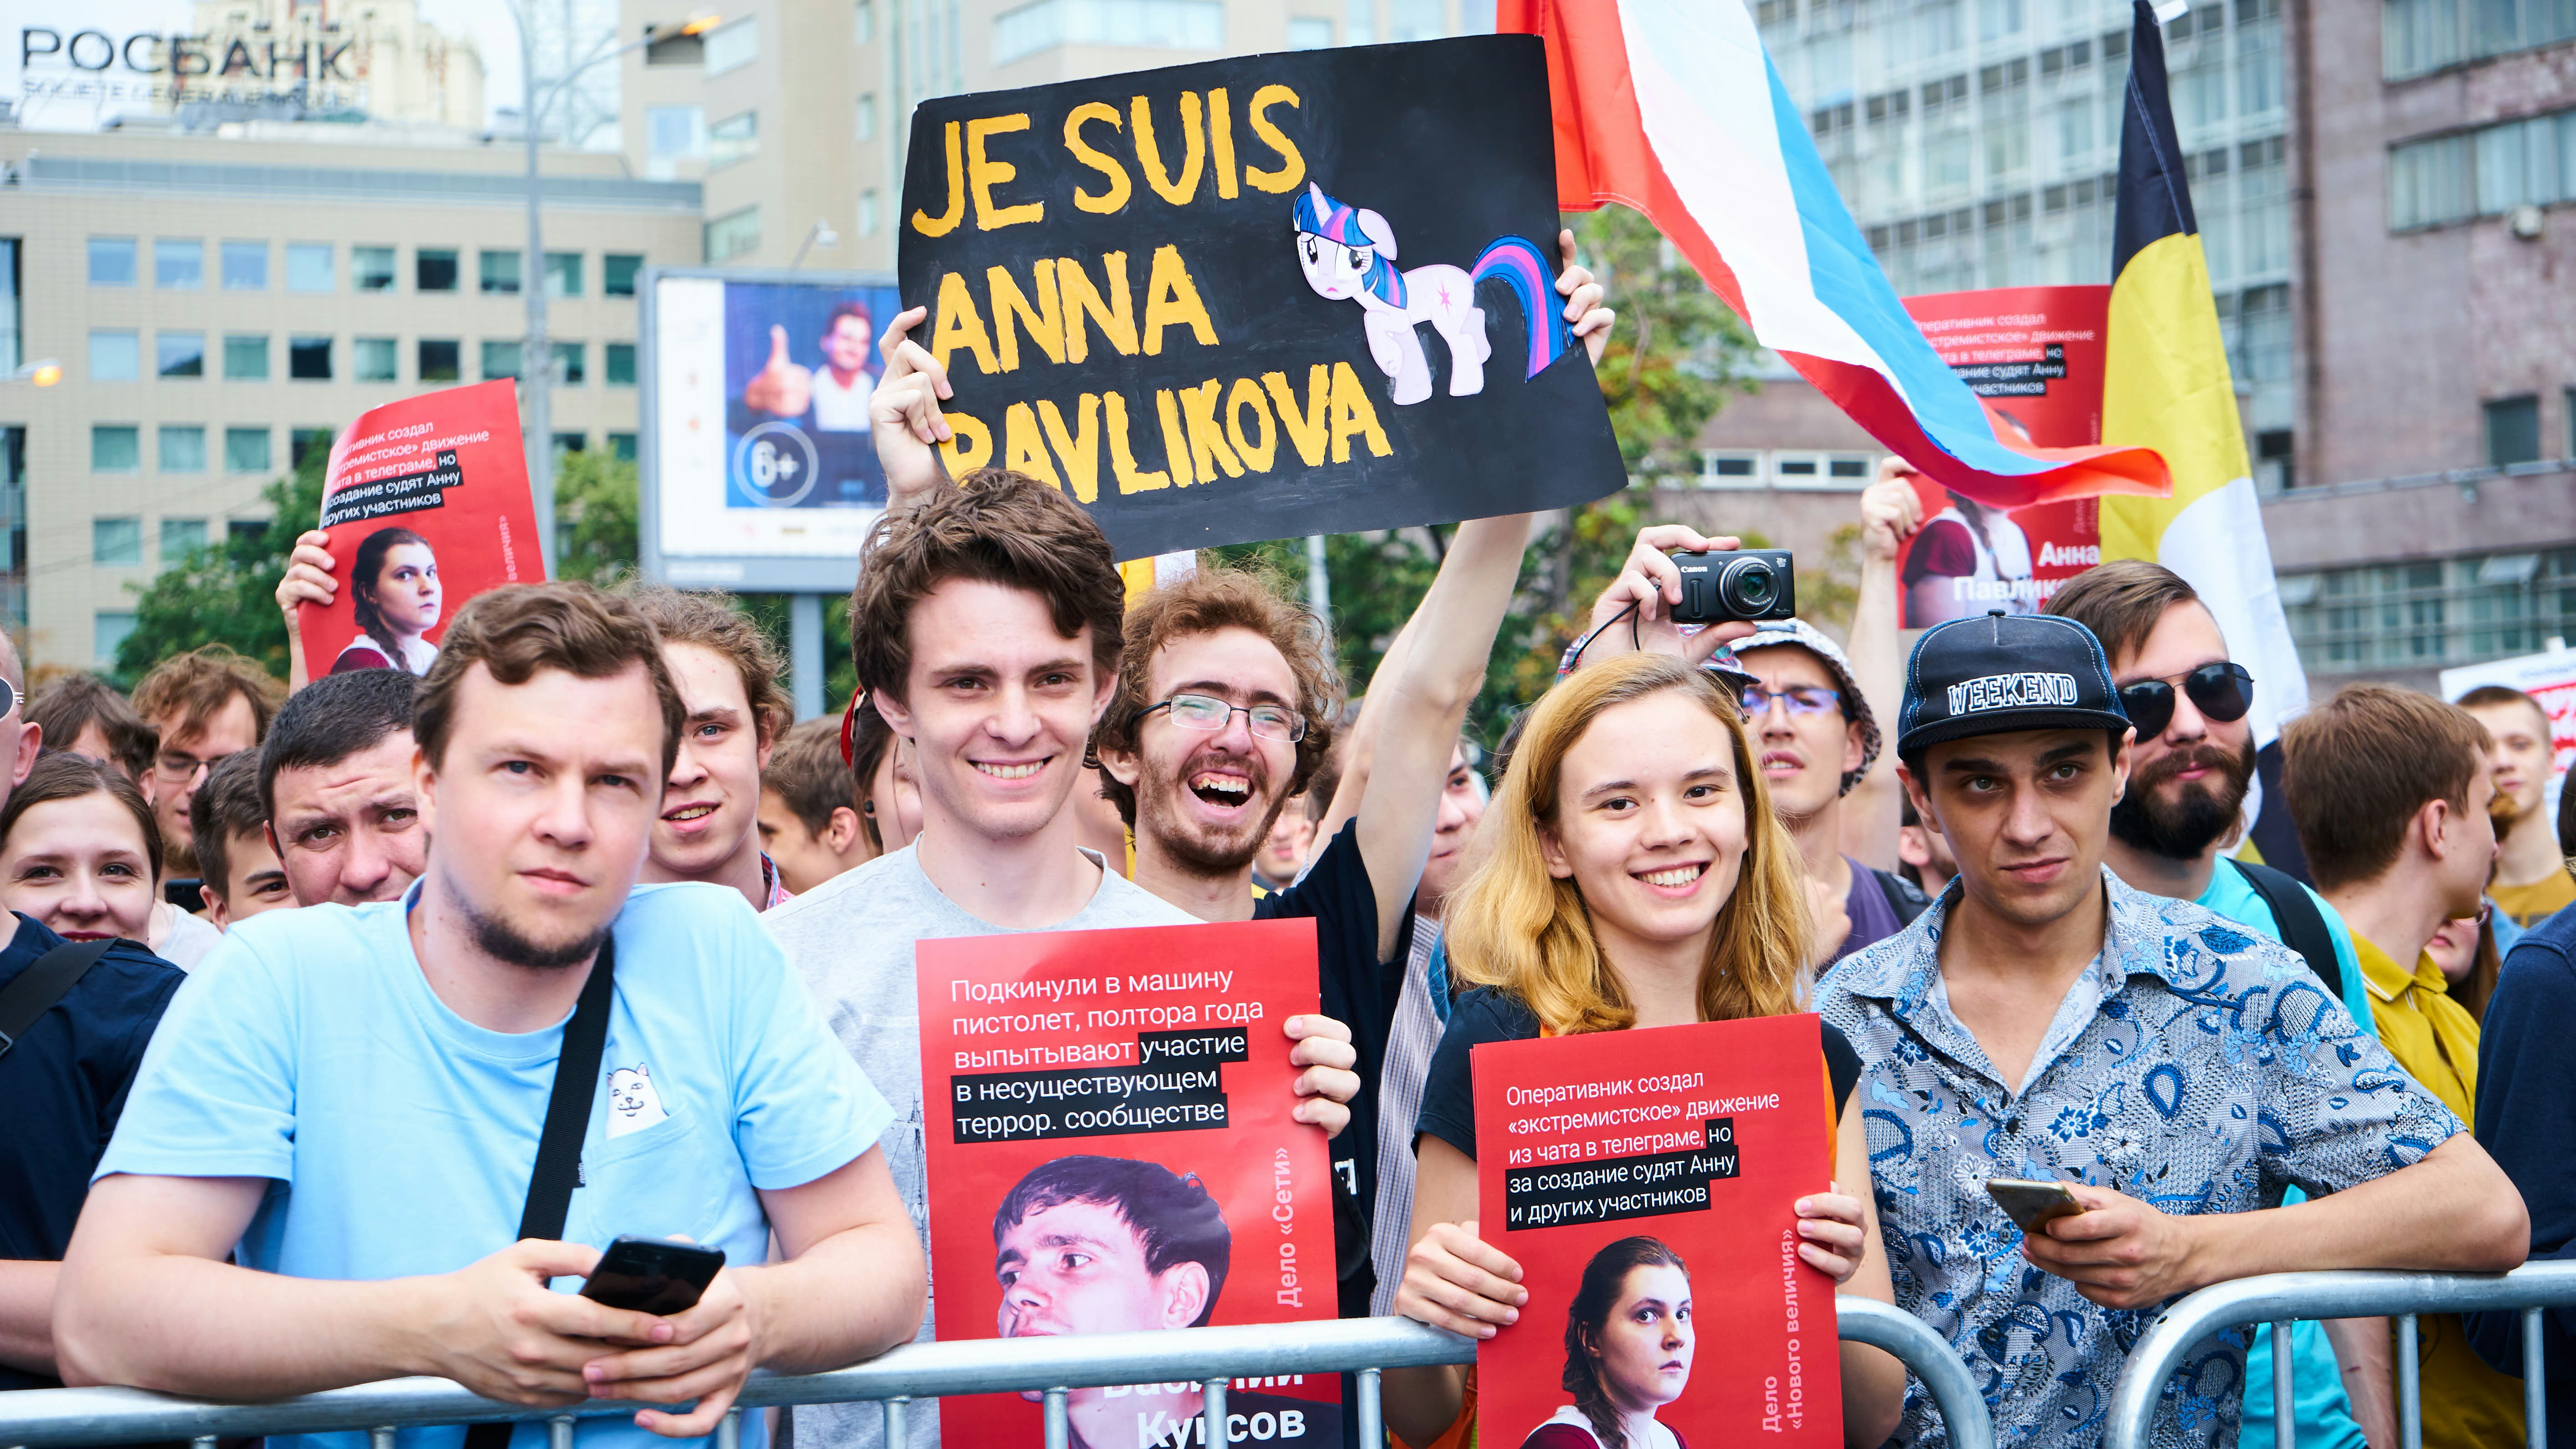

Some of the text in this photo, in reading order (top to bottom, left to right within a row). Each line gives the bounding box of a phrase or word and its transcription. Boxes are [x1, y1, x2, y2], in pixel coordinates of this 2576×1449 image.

[22, 27, 358, 80] РОСБАНК
[911, 84, 1306, 237] JE SUIS
[931, 244, 1219, 374] ANNA
[1997, 314, 2046, 326] создал
[1927, 329, 2095, 349] стремистское» движение
[1960, 351, 1970, 362] в
[2046, 347, 2063, 359] но
[1992, 365, 2029, 380] судят
[2032, 363, 2064, 378] Анну
[388, 422, 433, 441] создал
[421, 431, 489, 454] движение
[938, 362, 1392, 503] PAVLIKOVA
[354, 472, 361, 482] в
[364, 457, 435, 479] телеграме,
[438, 454, 455, 467] но
[751, 441, 799, 487] 6+
[329, 471, 460, 508] создание судят Анну
[322, 493, 441, 527] других участников
[2038, 542, 2100, 567] Анна
[1954, 578, 2068, 601] Павлик
[1948, 672, 2078, 716] WEEKEND
[951, 970, 1233, 1004] Подкинули в машину
[953, 1002, 1263, 1035] пистолет, полтора года
[955, 1036, 1245, 1069] выпытывают участие
[957, 1071, 1216, 1104] в несуществующем
[1507, 1073, 1703, 1107] Оперативник создал
[957, 1103, 1225, 1139] террор. сообществе
[1508, 1094, 1779, 1135] «экстремистское» движение
[1509, 1127, 1731, 1164] из чата в телеграме, но
[1510, 1155, 1735, 1193] за создание судят Анну
[1511, 1187, 1706, 1224] и других участников
[1272, 1147, 1303, 1307] Дело «Сети»
[1781, 1229, 1802, 1429] «Нового величия»
[1762, 1376, 1782, 1433] Дело
